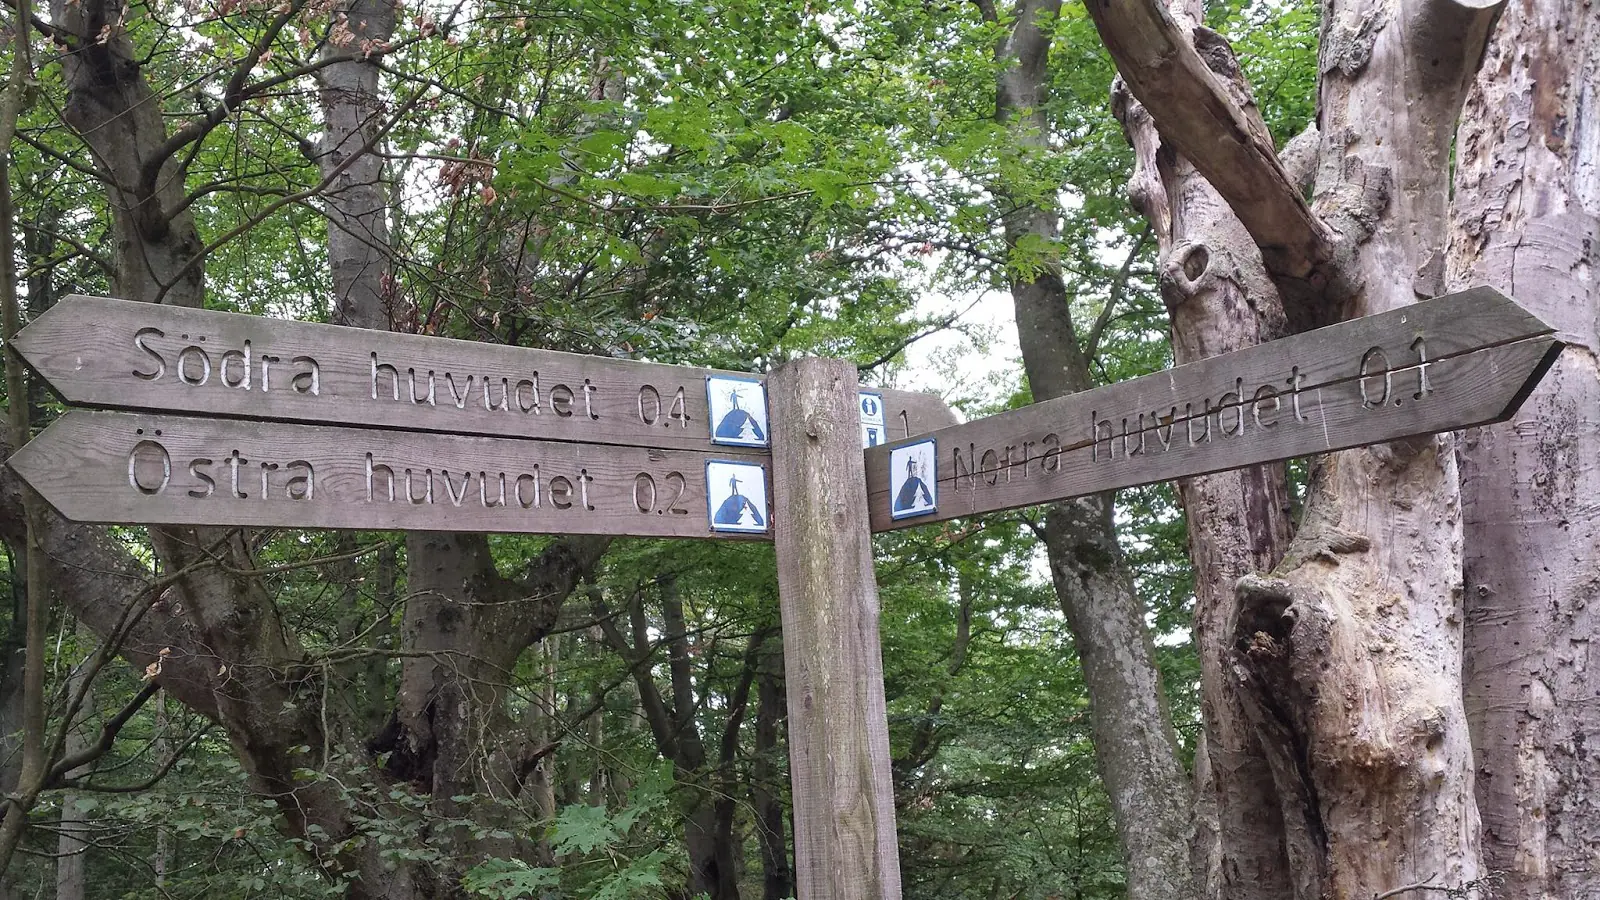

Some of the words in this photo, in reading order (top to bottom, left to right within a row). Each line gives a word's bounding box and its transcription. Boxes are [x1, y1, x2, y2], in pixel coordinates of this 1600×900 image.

[132, 327, 320, 396] Södra
[371, 352, 599, 421] huvudet
[637, 383, 691, 429] 0.4
[953, 433, 1061, 494] Norra
[1092, 365, 1308, 463] huvudet
[1359, 336, 1433, 411] 0.1
[128, 428, 315, 501] Östra
[366, 452, 596, 511] huvudet
[632, 470, 689, 516] 0.2
